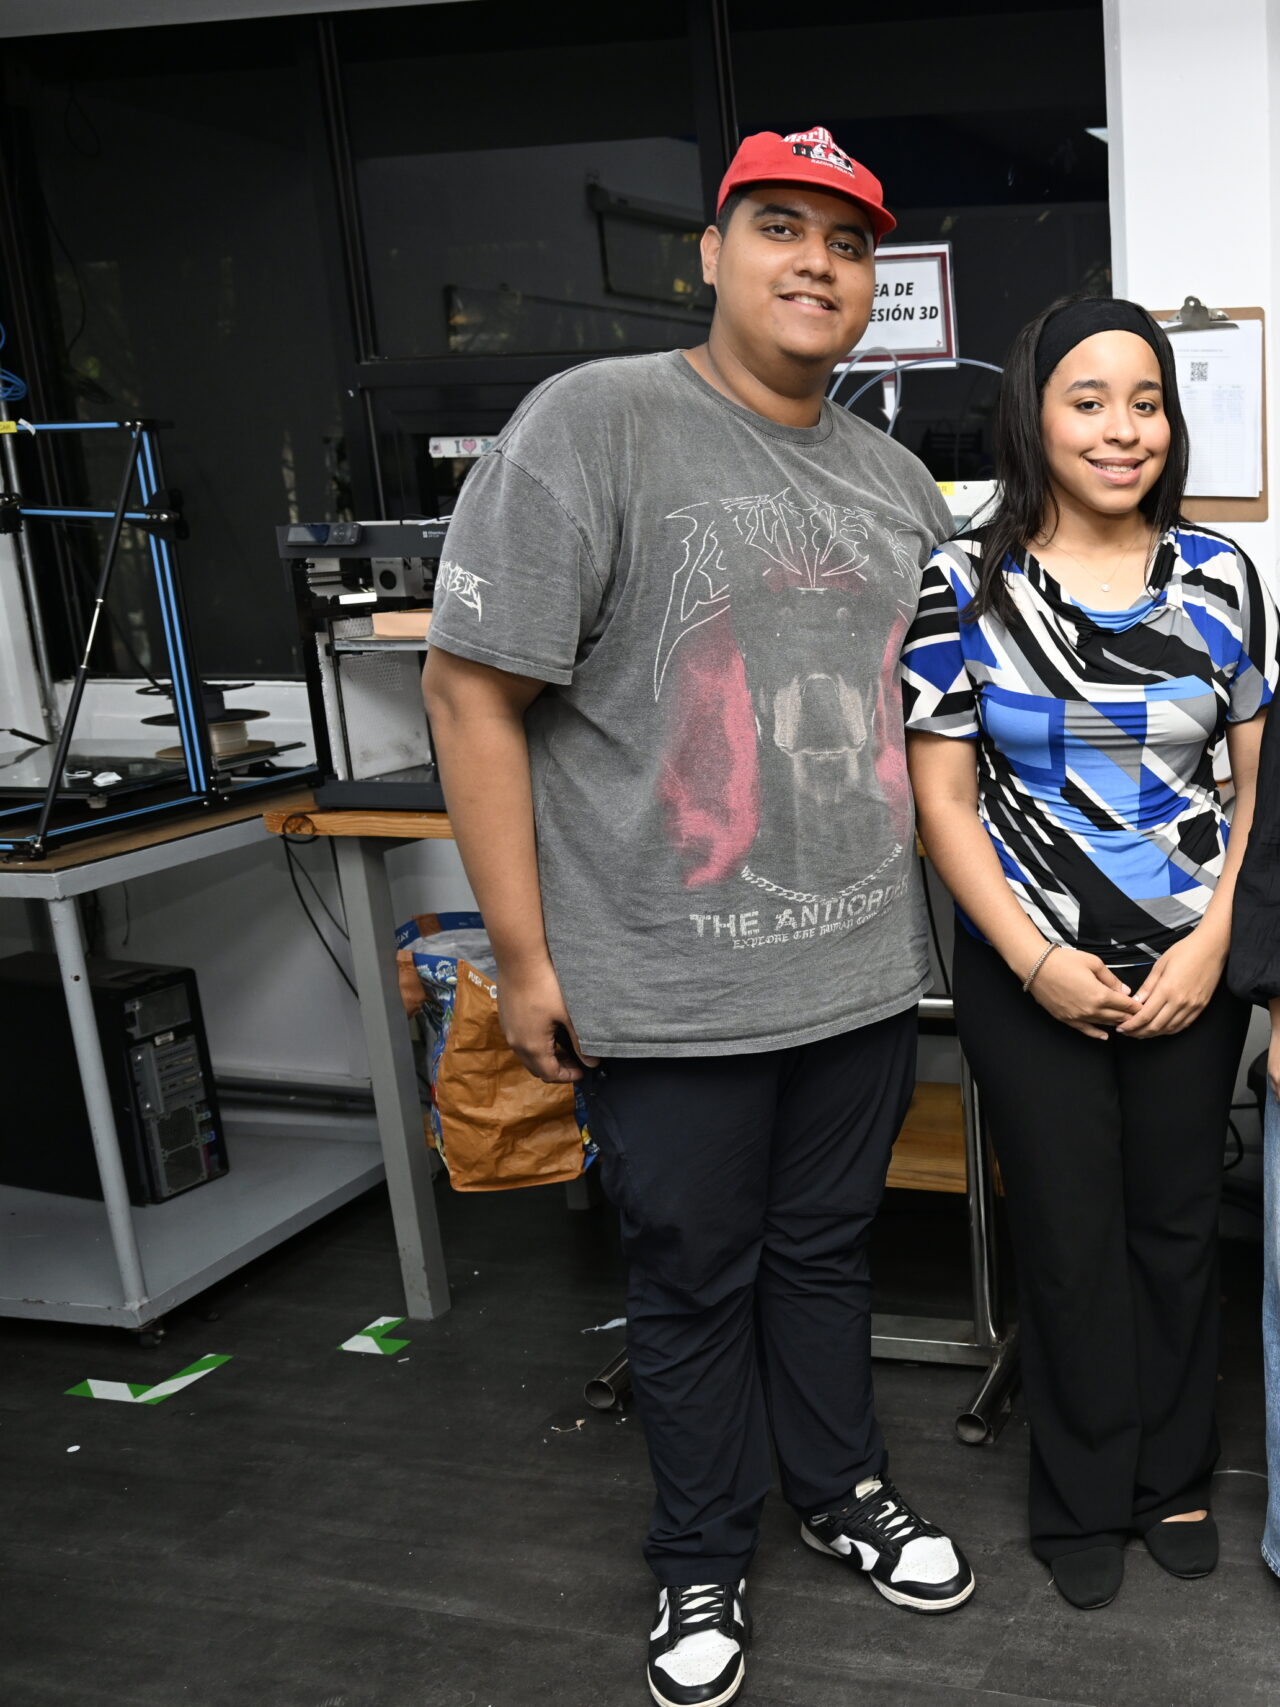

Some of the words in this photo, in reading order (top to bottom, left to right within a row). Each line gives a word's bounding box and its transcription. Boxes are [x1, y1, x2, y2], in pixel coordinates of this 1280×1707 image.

[874, 283, 889, 297] EA
[894, 282, 914, 297] DE
[869, 304, 915, 322] ESIÓN
[919, 306, 939, 320] 3D
[689, 910, 760, 938] THE
